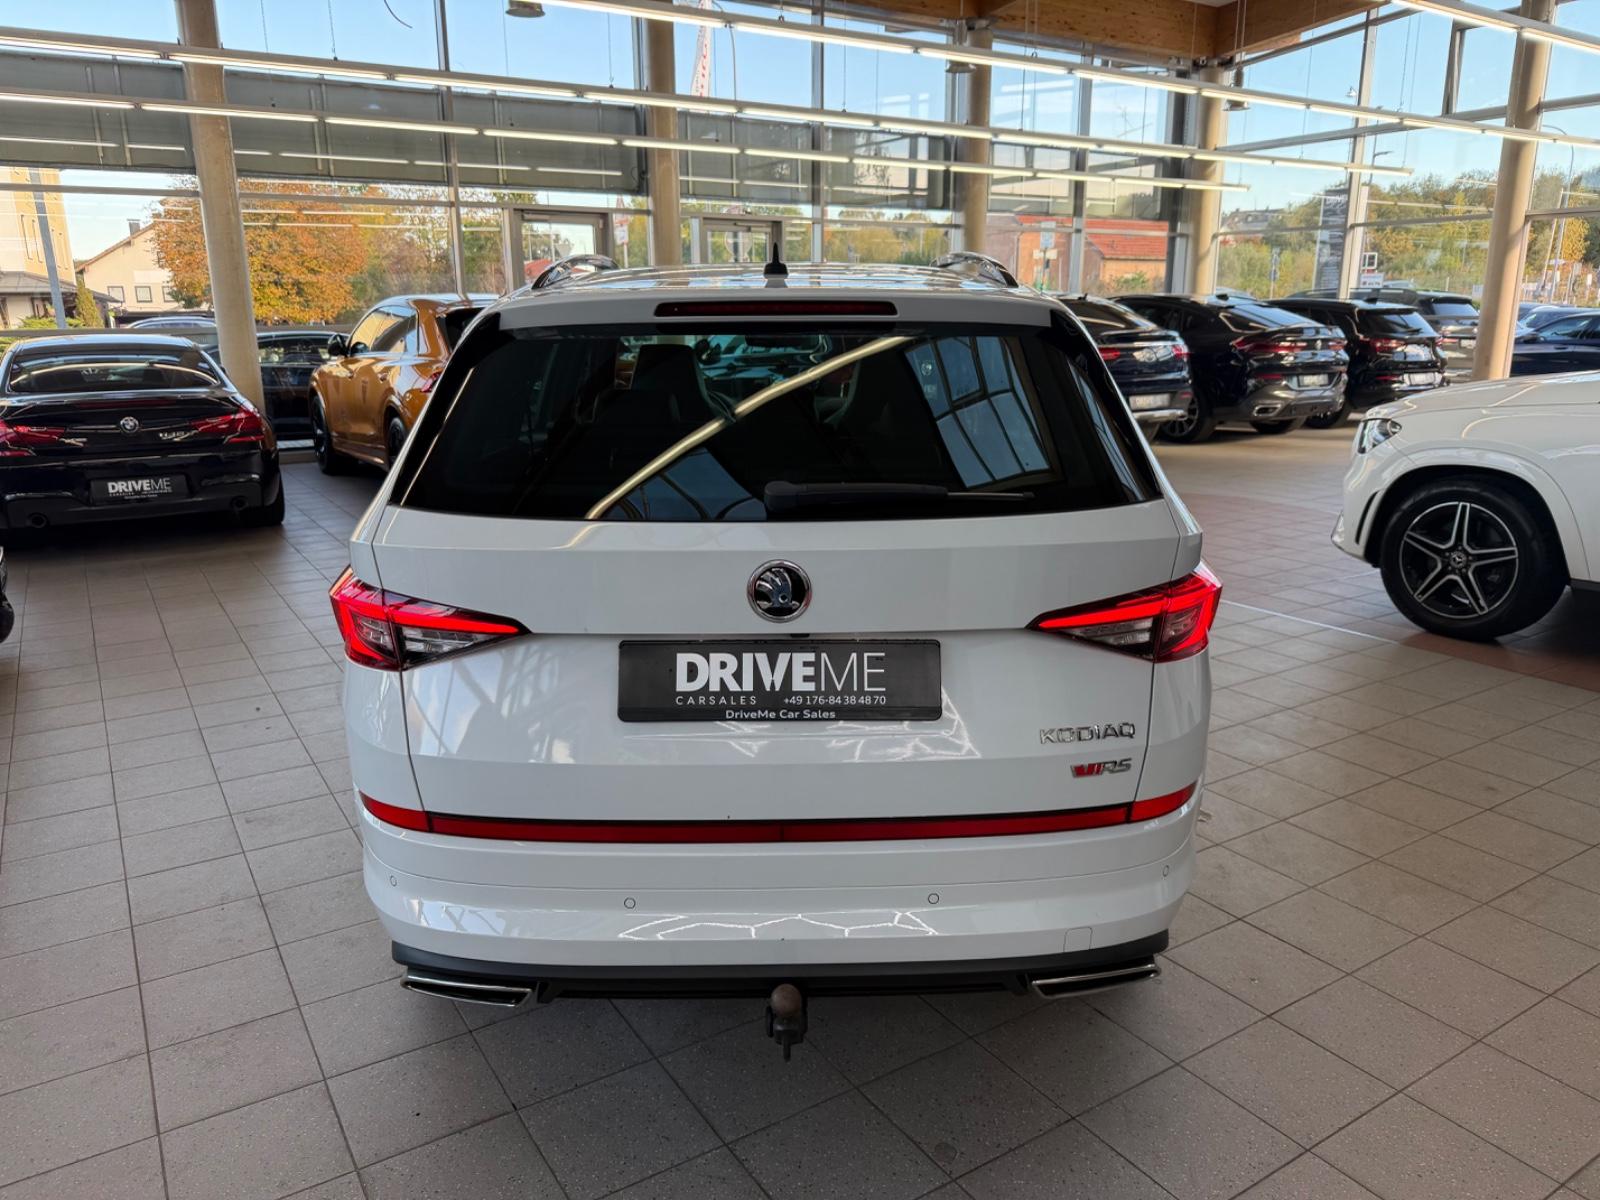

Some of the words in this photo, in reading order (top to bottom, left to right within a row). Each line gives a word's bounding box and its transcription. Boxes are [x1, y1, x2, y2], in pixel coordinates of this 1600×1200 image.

[107, 478, 171, 493] DRIVEME
[675, 652, 886, 692] DRIVEME
[675, 695, 757, 705] CARSALES
[725, 709, 776, 719] DriveMe
[779, 709, 800, 719] Car
[802, 709, 836, 719] Sales
[1039, 722, 1136, 744] KODIAQ
